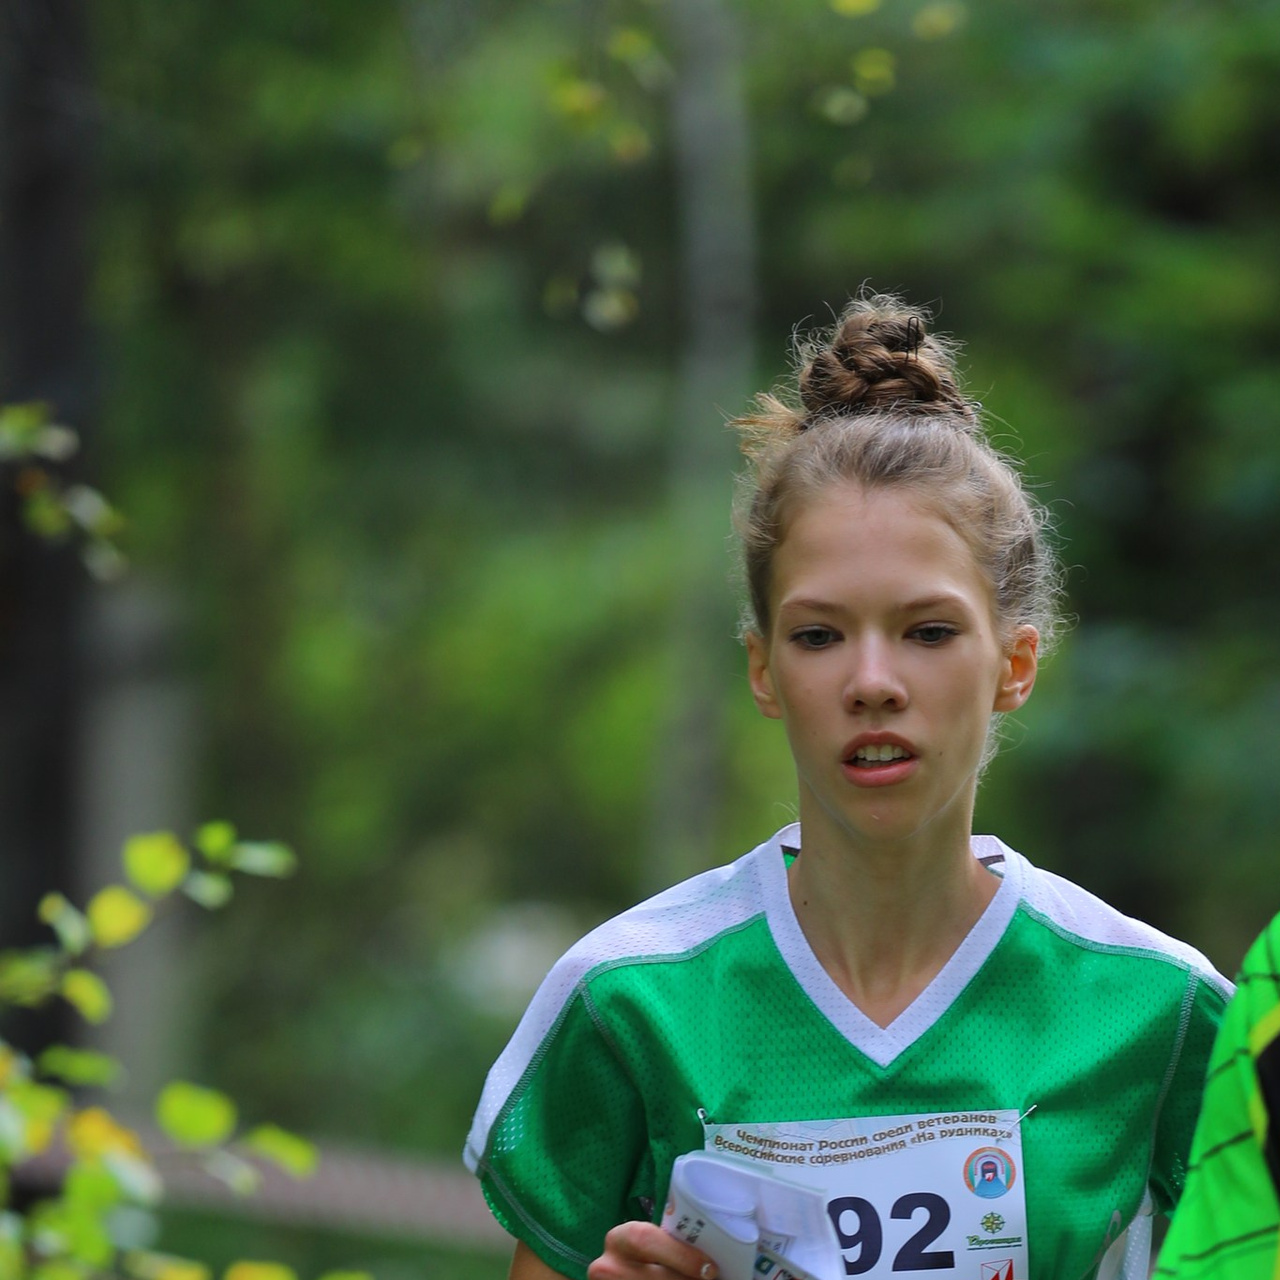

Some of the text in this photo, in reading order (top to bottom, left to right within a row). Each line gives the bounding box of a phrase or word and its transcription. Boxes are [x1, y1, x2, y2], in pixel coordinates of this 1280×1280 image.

[714, 1134, 805, 1165] Всероссийские
[809, 1139, 907, 1167] соревнования
[736, 1113, 997, 1151] Чемпионат России среди ветеранов
[827, 1192, 955, 1276] 92
